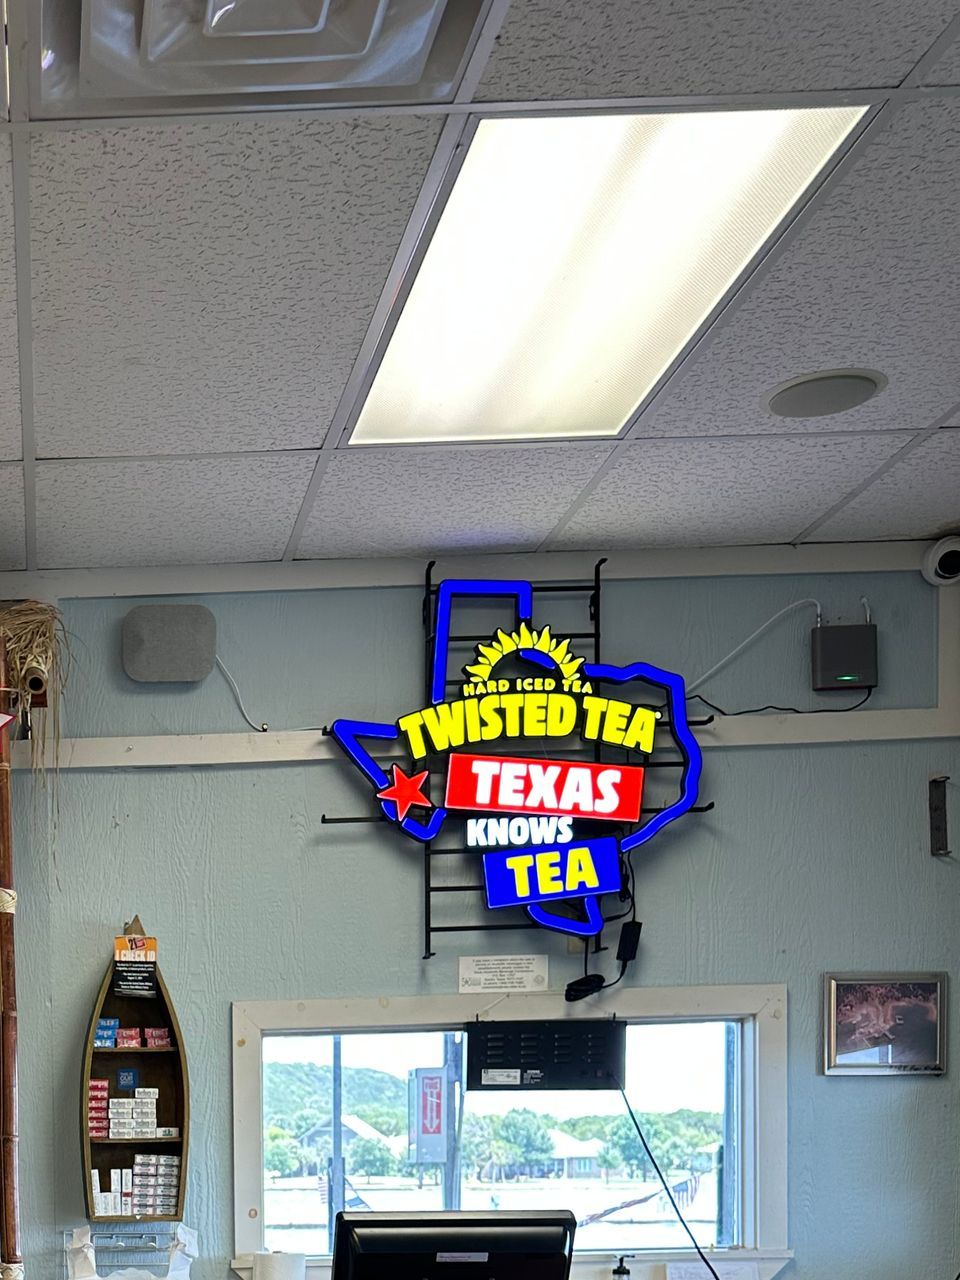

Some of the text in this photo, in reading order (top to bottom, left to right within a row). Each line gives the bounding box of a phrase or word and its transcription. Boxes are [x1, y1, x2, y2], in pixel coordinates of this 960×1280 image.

[463, 677, 593, 697] HARD ICED TEA
[399, 693, 656, 760] TWISTED TEA
[471, 760, 622, 813] TEXAS
[466, 816, 573, 846] KNOWS
[506, 848, 600, 898] TEA
[121, 950, 145, 961] CHECK
